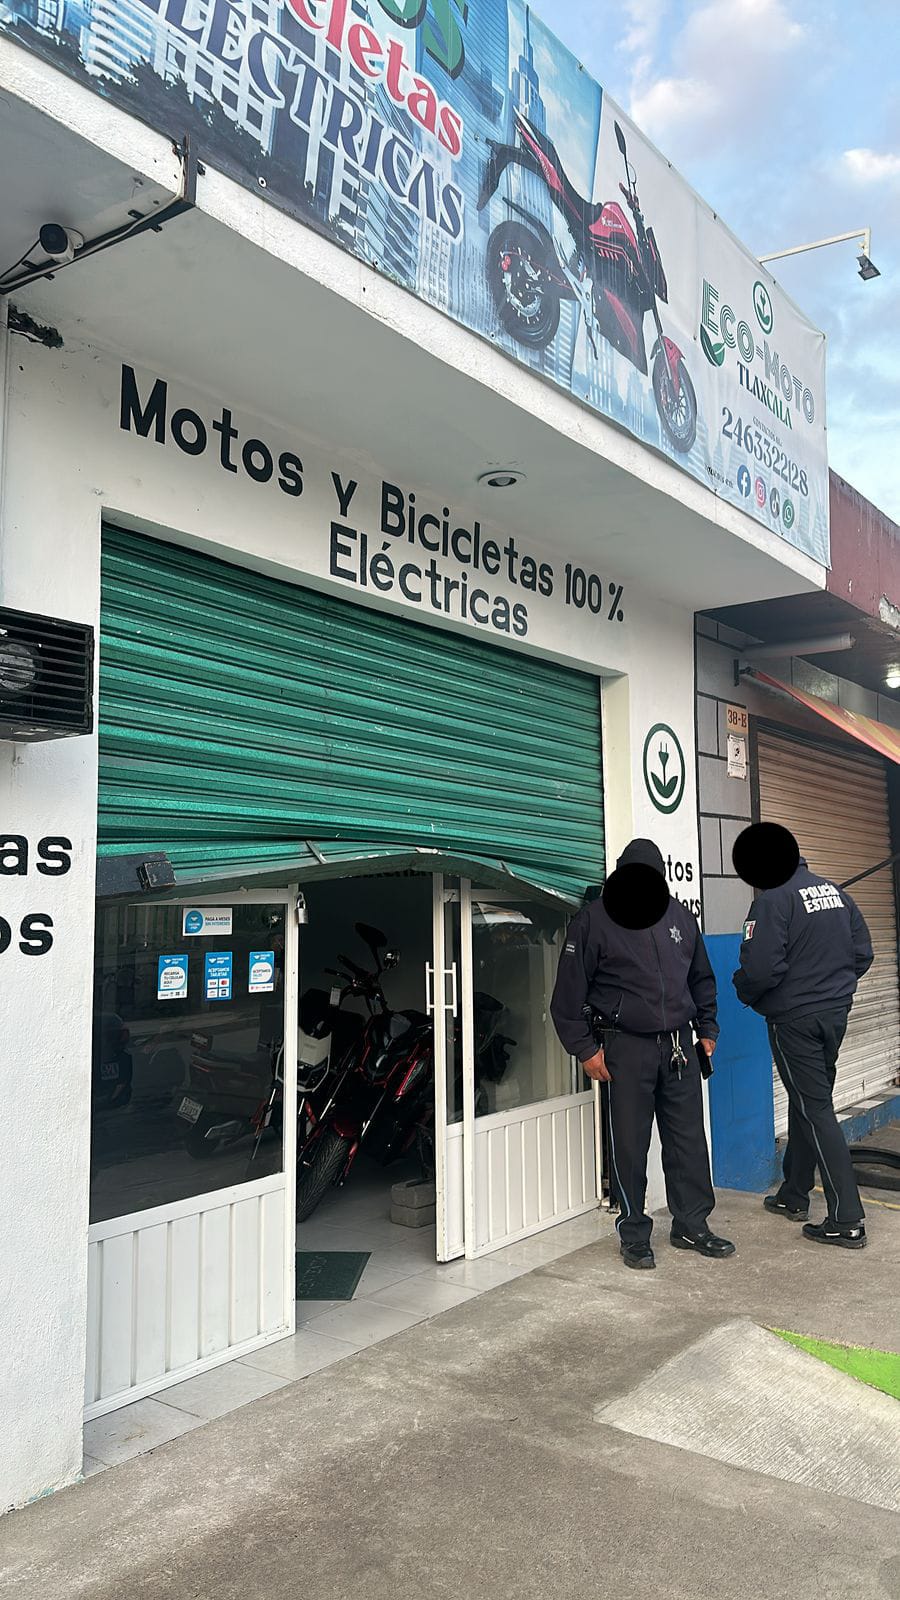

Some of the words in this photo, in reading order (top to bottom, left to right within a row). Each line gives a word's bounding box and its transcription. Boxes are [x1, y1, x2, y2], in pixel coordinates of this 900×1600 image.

[138, 0, 462, 238] LECTRICAS
[736, 361, 793, 430] TLAXCALA
[722, 406, 808, 497] 2463322128
[120, 363, 304, 497] Motos
[380, 481, 553, 598] Bicicletas
[565, 563, 602, 614] 100
[607, 582, 624, 622] %
[330, 520, 528, 637] Eléctricas
[0, 834, 73, 876] as
[666, 854, 693, 882] tos
[798, 882, 840, 900] POLICÍA
[803, 895, 845, 914] ESTATAL
